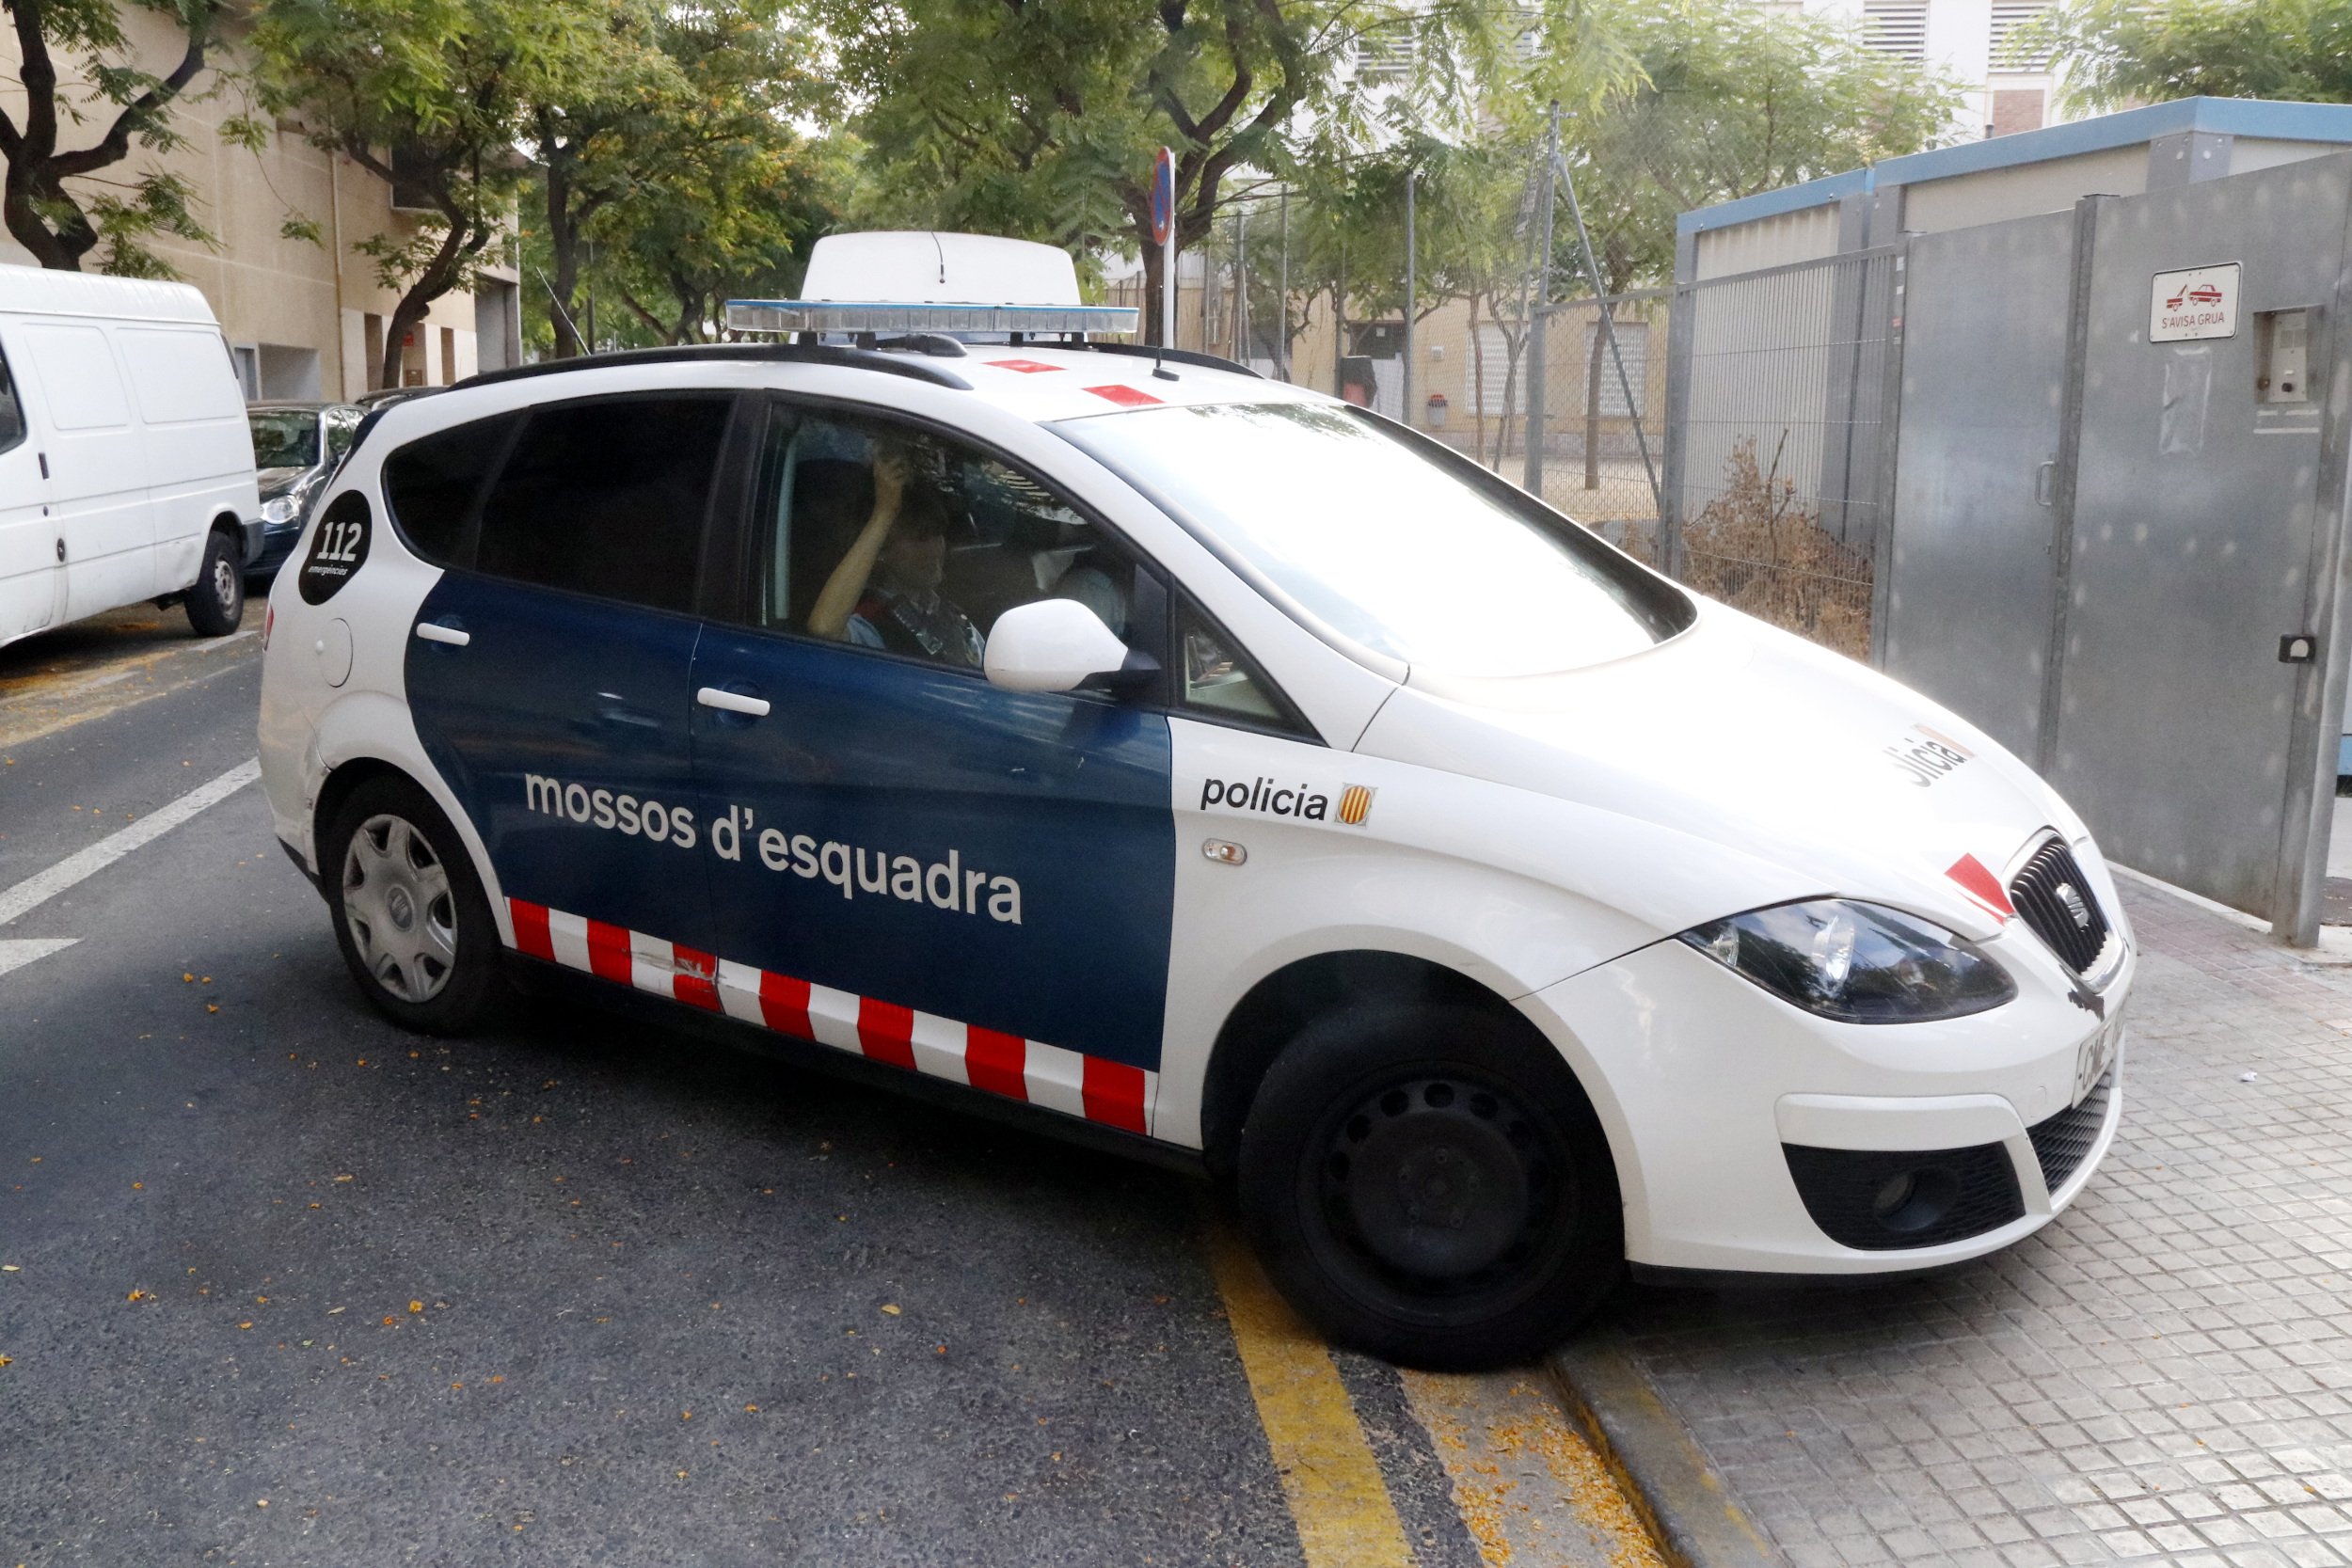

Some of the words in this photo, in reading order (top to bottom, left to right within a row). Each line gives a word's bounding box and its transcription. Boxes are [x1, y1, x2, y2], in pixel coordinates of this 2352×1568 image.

[2161, 314, 2195, 329] S'AVISA
[2198, 311, 2225, 325] GRUA
[316, 521, 362, 562] 112
[524, 773, 697, 849] mossos
[1200, 776, 1329, 821] policia
